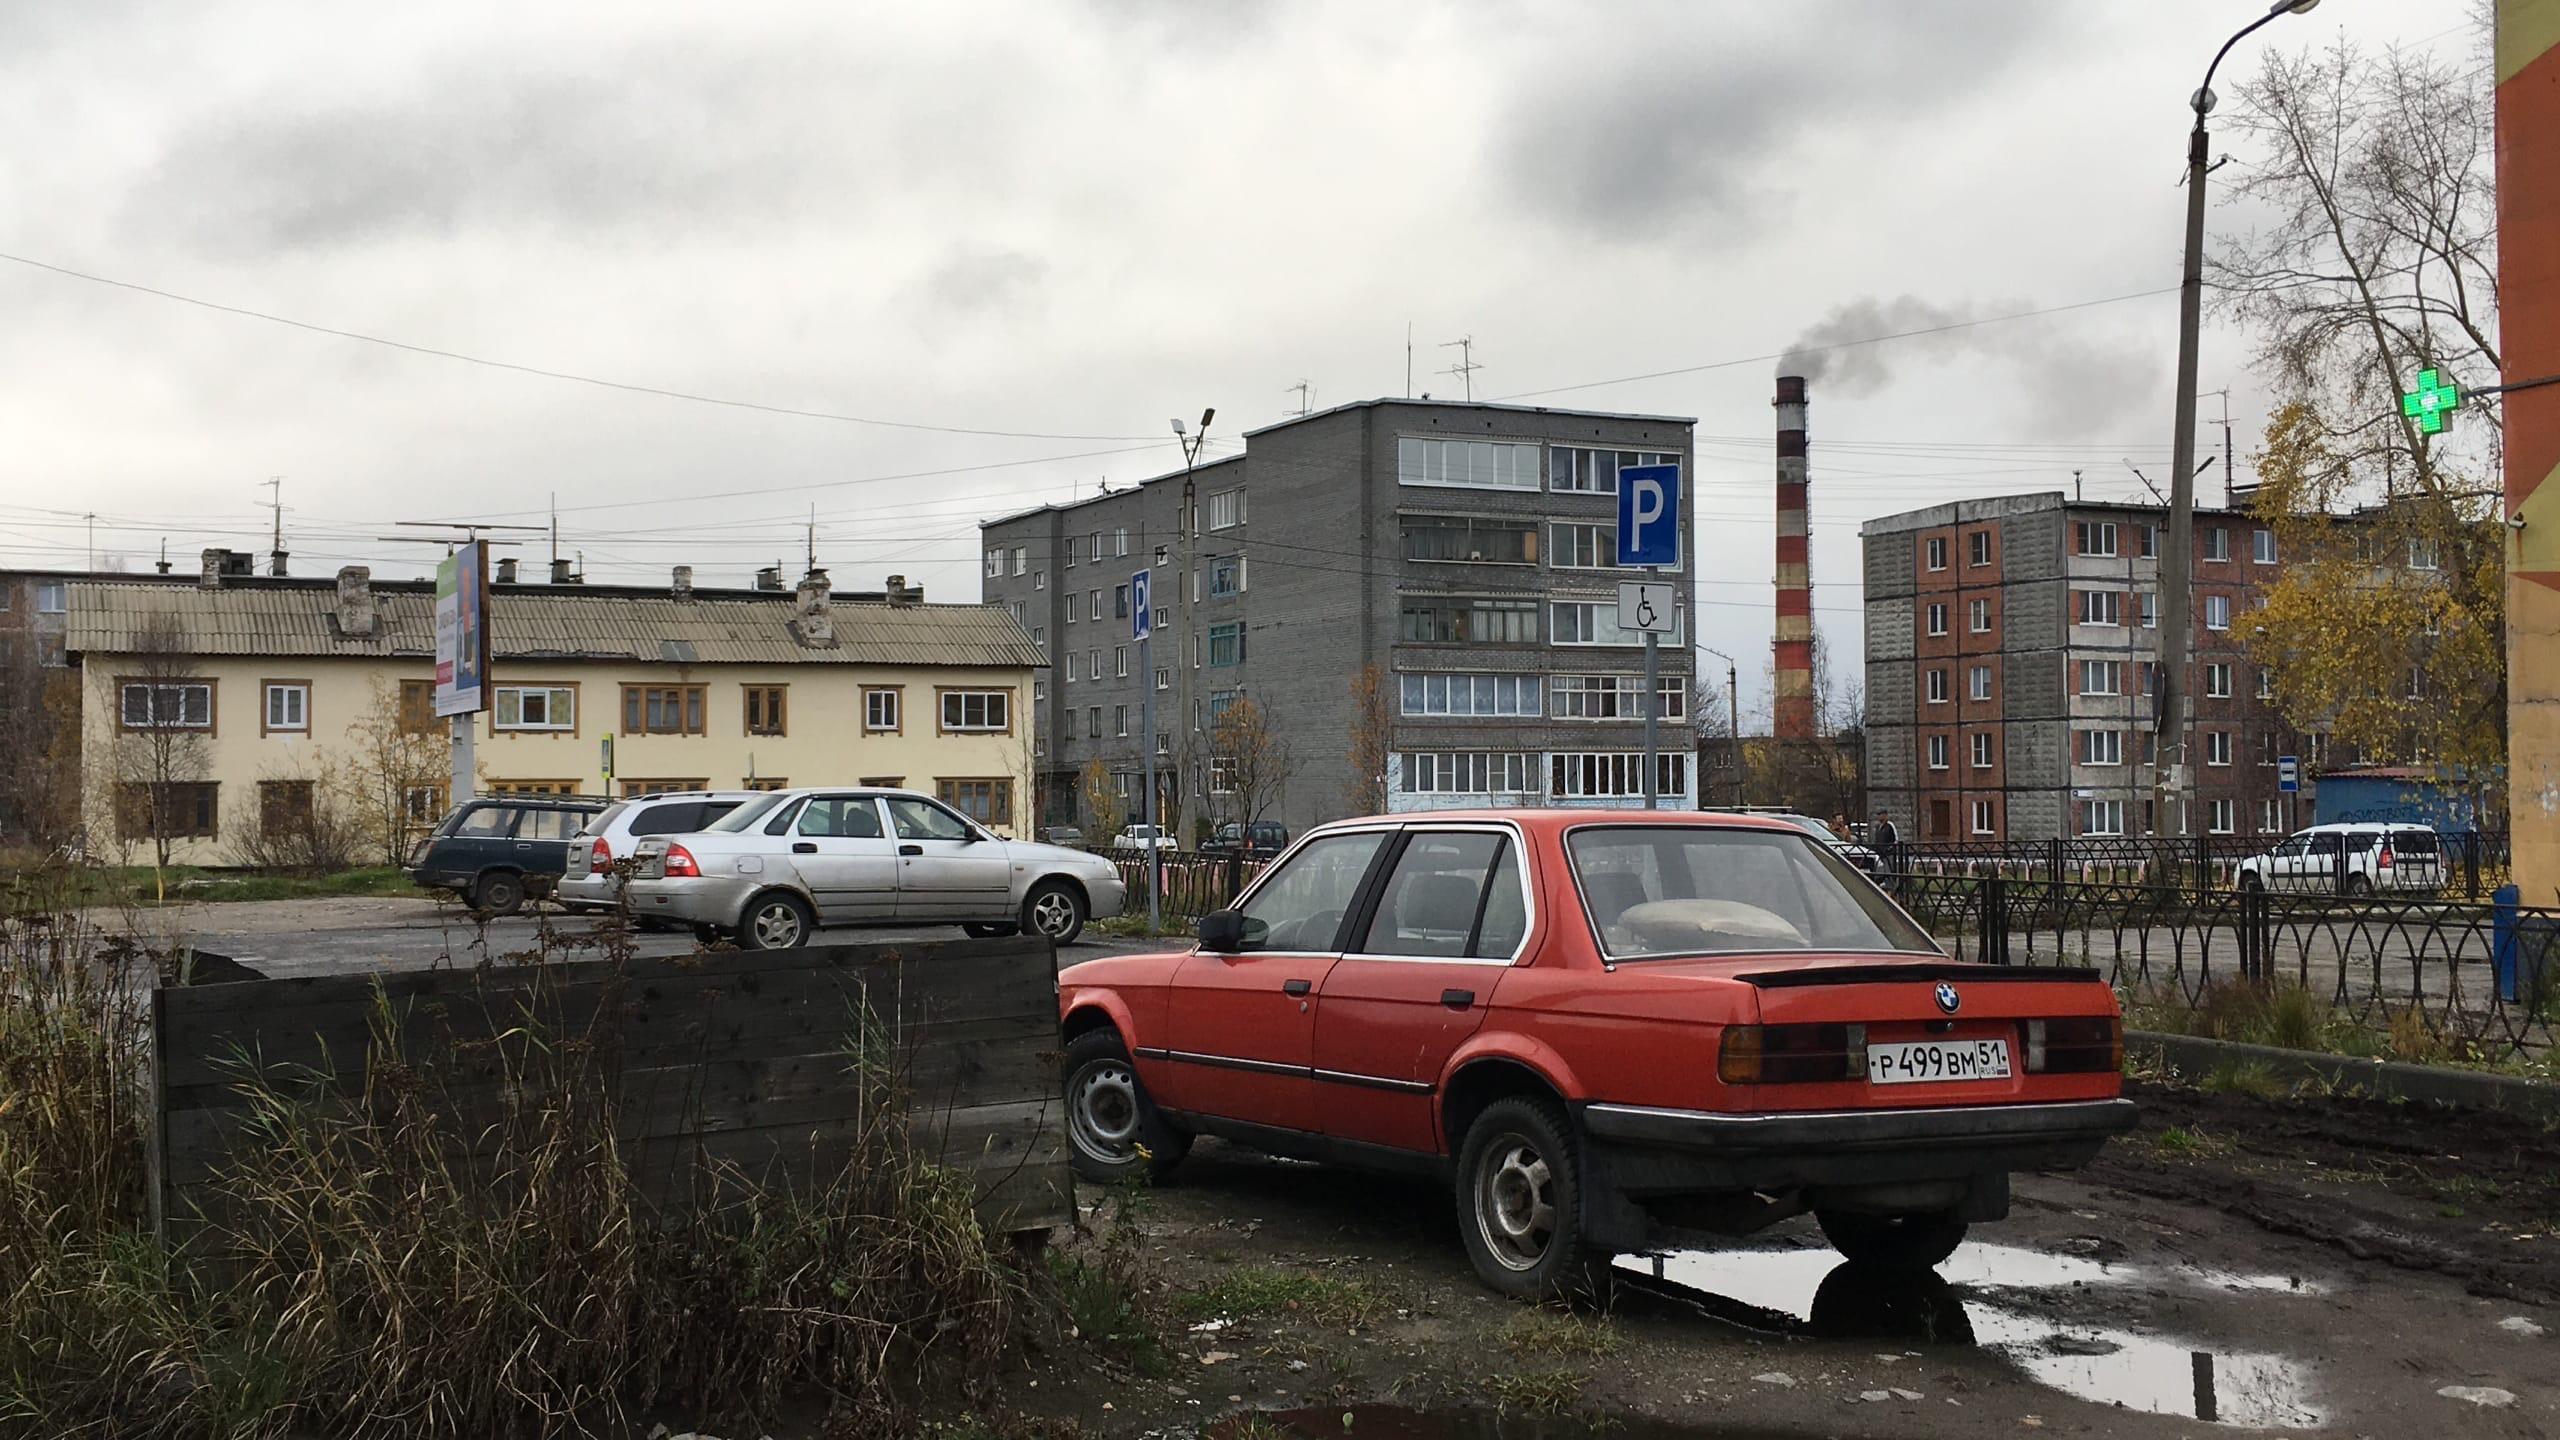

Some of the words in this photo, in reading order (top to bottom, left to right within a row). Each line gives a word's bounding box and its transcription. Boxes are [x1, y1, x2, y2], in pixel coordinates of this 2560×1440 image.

[1631, 479, 1664, 552] P
[1135, 580, 1146, 633] P
[1978, 1042, 2001, 1066] 51
[1980, 1066, 1996, 1075] RUS
